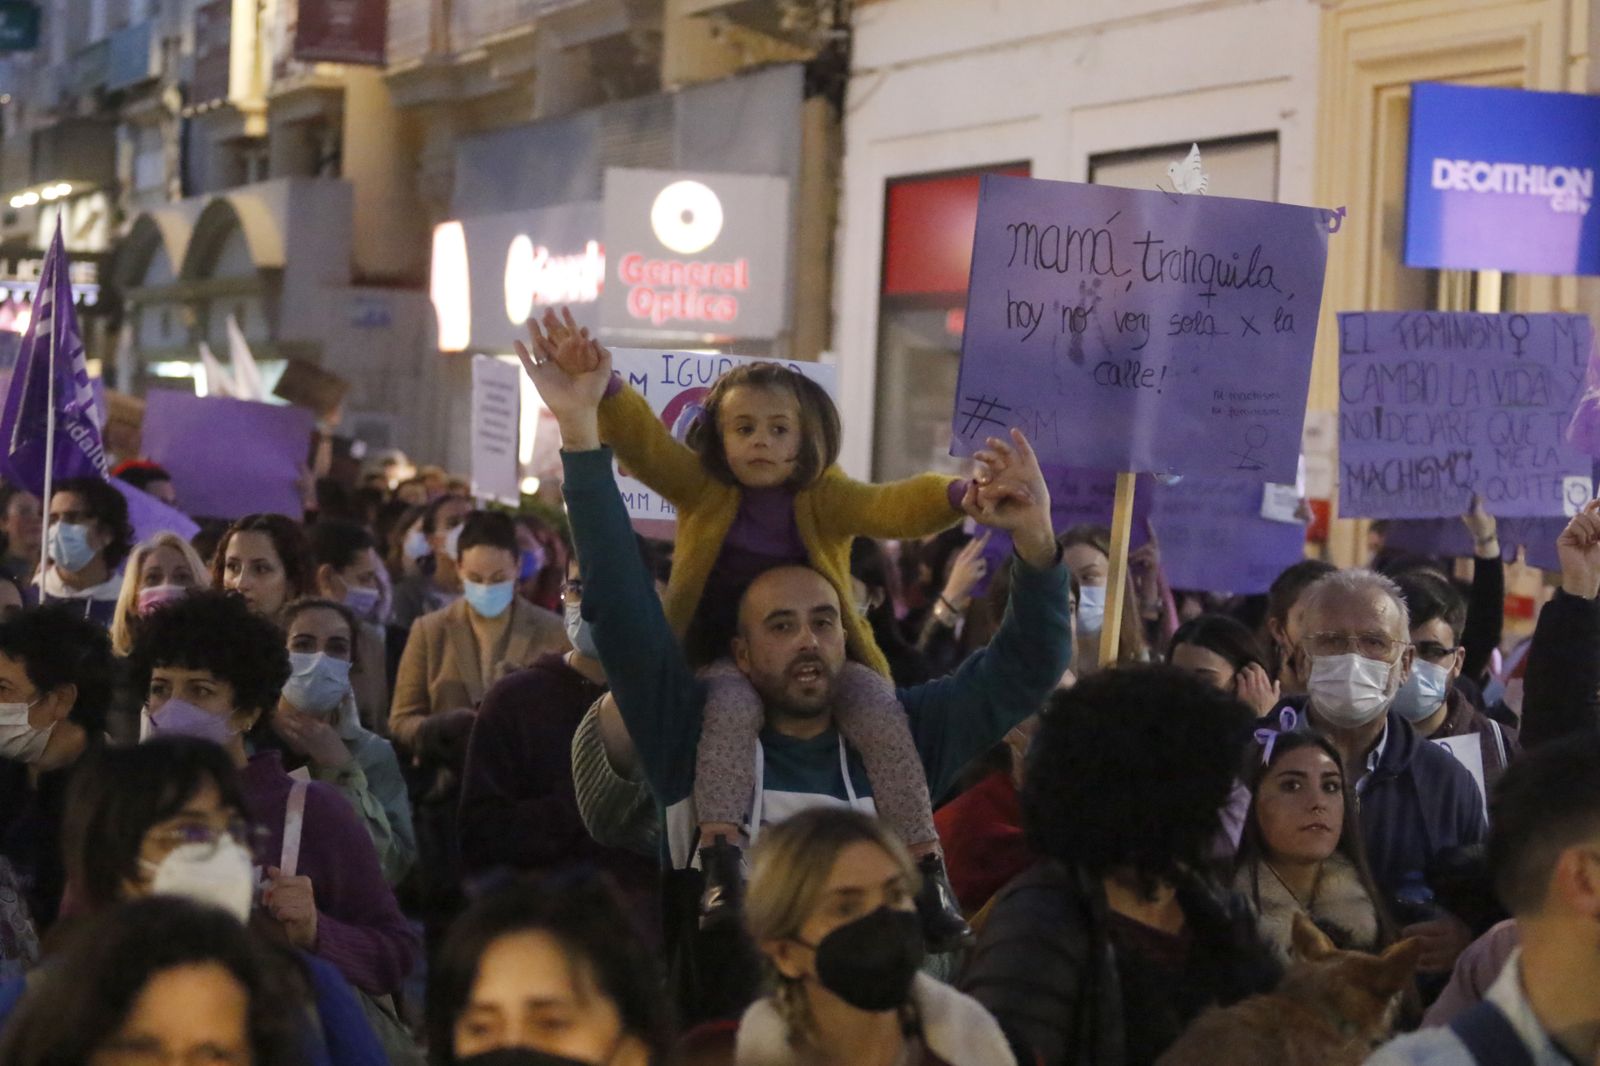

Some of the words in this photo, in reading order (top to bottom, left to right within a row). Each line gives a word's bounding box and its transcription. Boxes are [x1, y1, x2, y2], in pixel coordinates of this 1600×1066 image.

[1431, 158, 1594, 197] DECATHLON
[618, 252, 750, 290] General
[1006, 290, 1044, 342] hoy
[1114, 311, 1150, 351] voy
[1093, 360, 1168, 394] calle!
